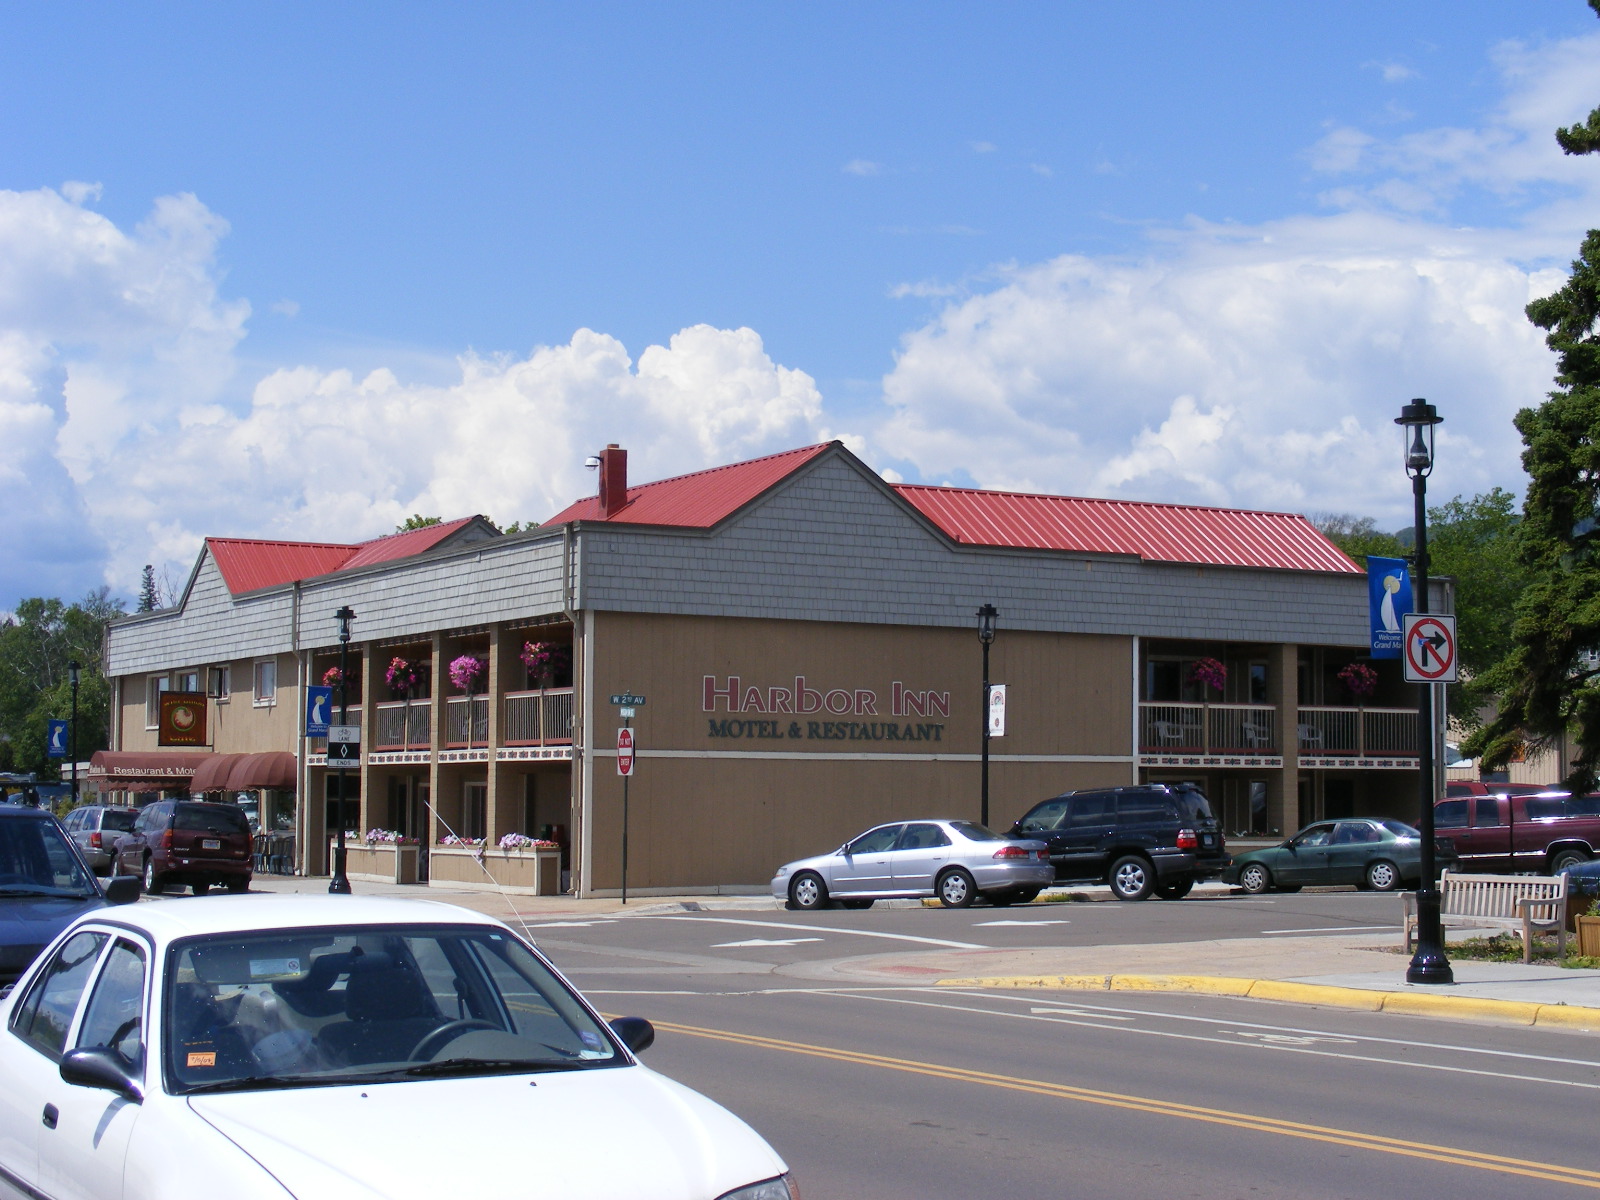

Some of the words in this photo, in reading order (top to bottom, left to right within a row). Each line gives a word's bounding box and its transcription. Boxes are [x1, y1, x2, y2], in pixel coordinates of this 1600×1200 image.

[1373, 641, 1391, 649] Grand
[612, 696, 620, 704] W
[708, 719, 784, 739] MOTEL
[788, 720, 803, 739] &
[807, 721, 944, 741] RESTAURANT
[113, 766, 165, 775] Restaurant
[166, 767, 173, 775] &
[175, 767, 197, 775] Mote
